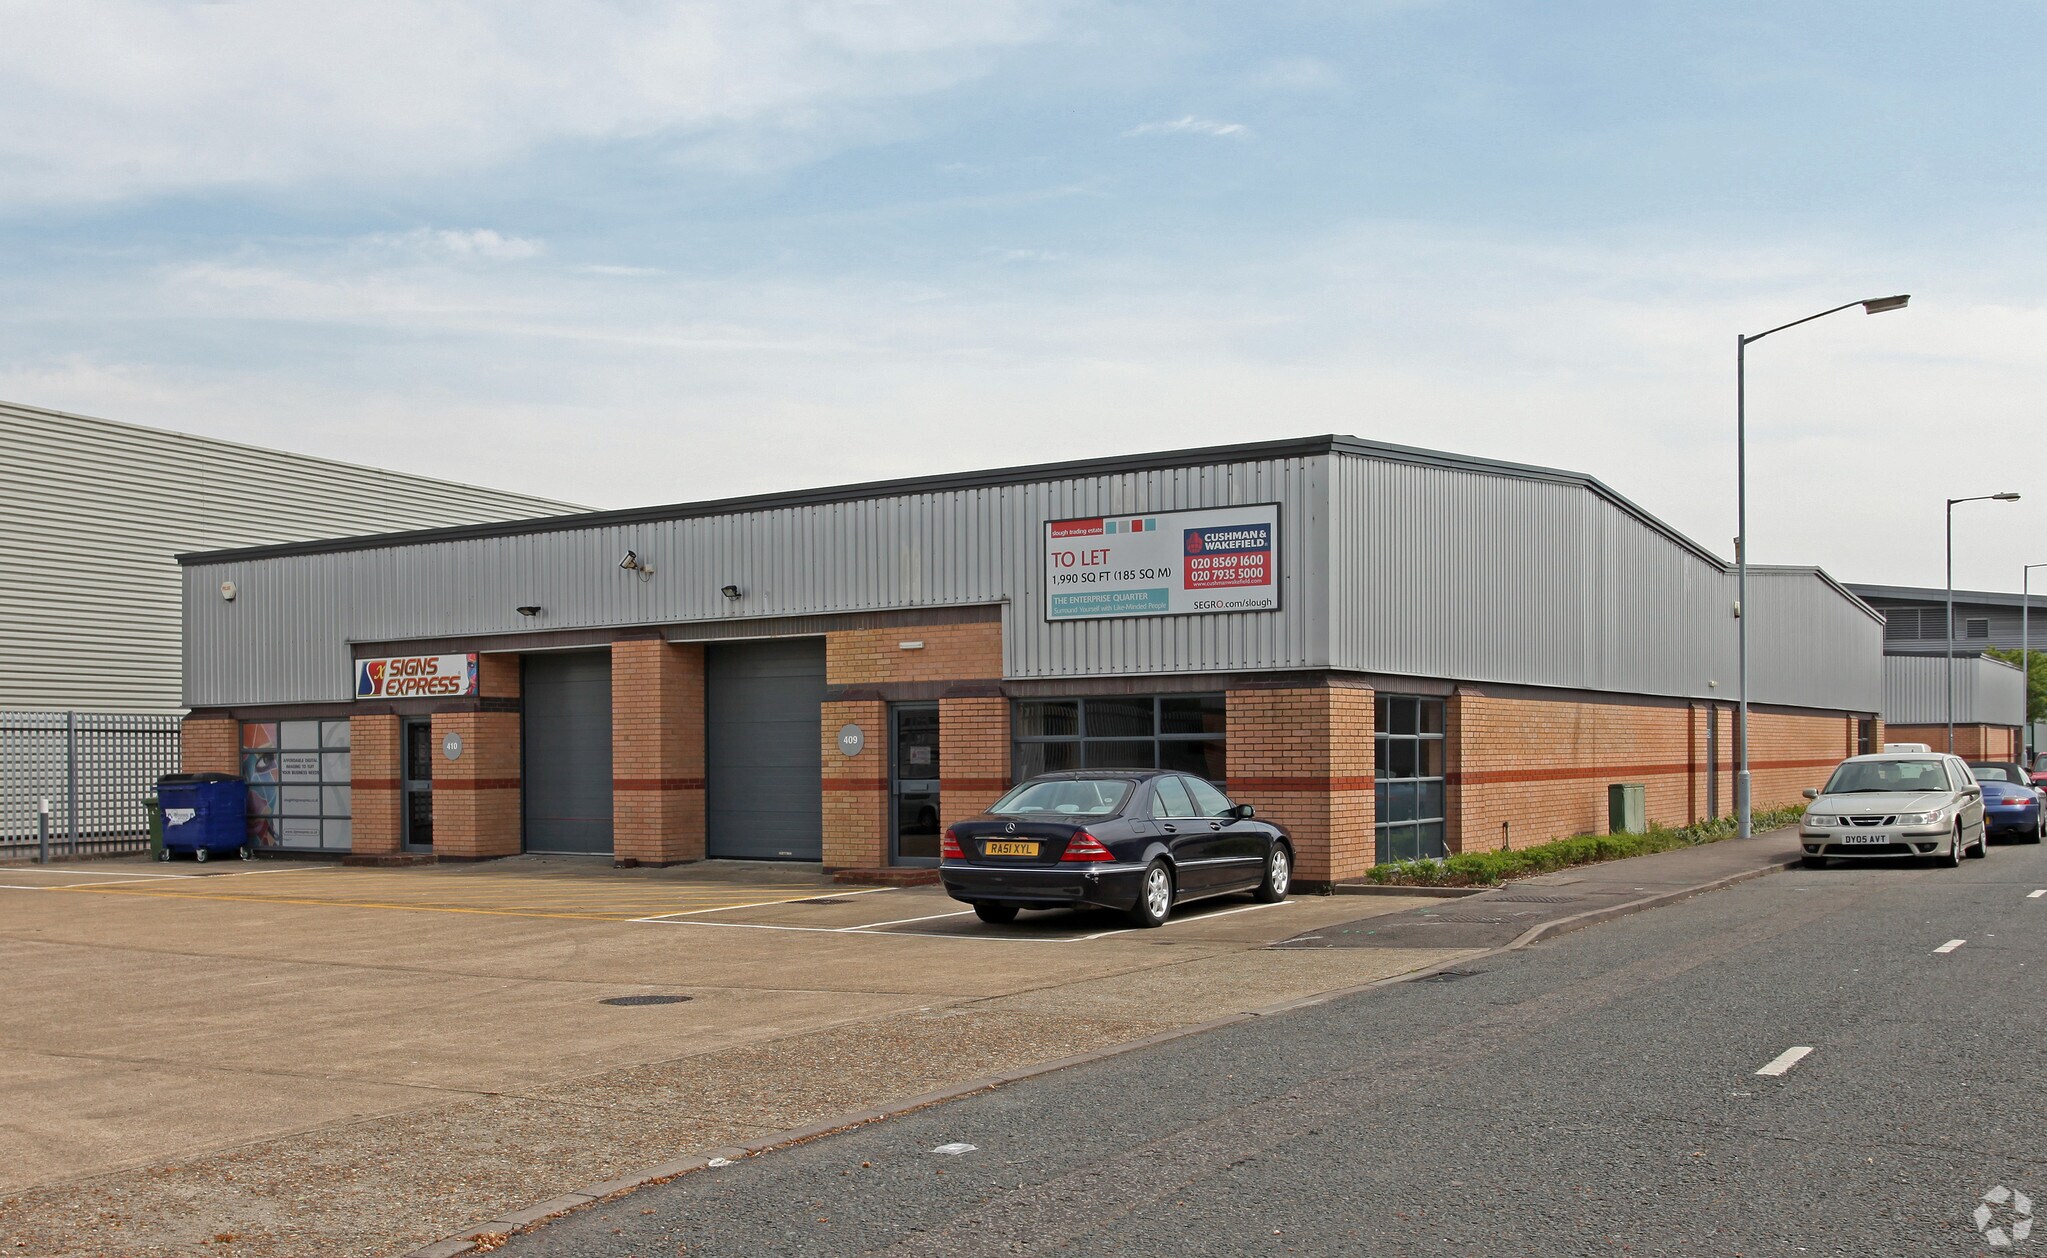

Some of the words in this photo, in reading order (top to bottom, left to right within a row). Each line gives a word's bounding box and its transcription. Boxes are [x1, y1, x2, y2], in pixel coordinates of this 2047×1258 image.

[1052, 529, 1069, 537] slough
[1070, 528, 1087, 536] trading
[1205, 531, 1258, 542] CUSHMAN
[1259, 530, 1267, 539] &
[1051, 551, 1076, 568] TO
[1082, 549, 1111, 566] LET
[1192, 558, 1211, 569] 020
[1213, 556, 1238, 568] 8569
[1241, 555, 1264, 566] 1600
[1053, 574, 1078, 586] 1,990
[1081, 572, 1096, 583] SQ
[1100, 572, 1111, 582] FT
[1114, 570, 1136, 581] (185
[1140, 569, 1155, 579] SQ
[1158, 568, 1171, 578] M)
[1192, 571, 1210, 582] 020
[1212, 569, 1236, 580] 7935
[1238, 568, 1264, 579] 5000
[1055, 597, 1068, 605] THE
[1070, 595, 1111, 604] ENTERPRISE
[1113, 593, 1148, 602] QUARTER
[1194, 598, 1272, 610] SEGRO.com/slough
[1054, 606, 1078, 614] Surround
[1079, 605, 1100, 613] Yourself
[1114, 603, 1147, 611] Like-Minded
[1149, 602, 1167, 610] People
[389, 657, 439, 677] SIGNS
[386, 676, 461, 696] EXPRESS
[843, 736, 858, 745] 409
[992, 844, 1012, 854] RA51
[1014, 844, 1032, 854] XYL
